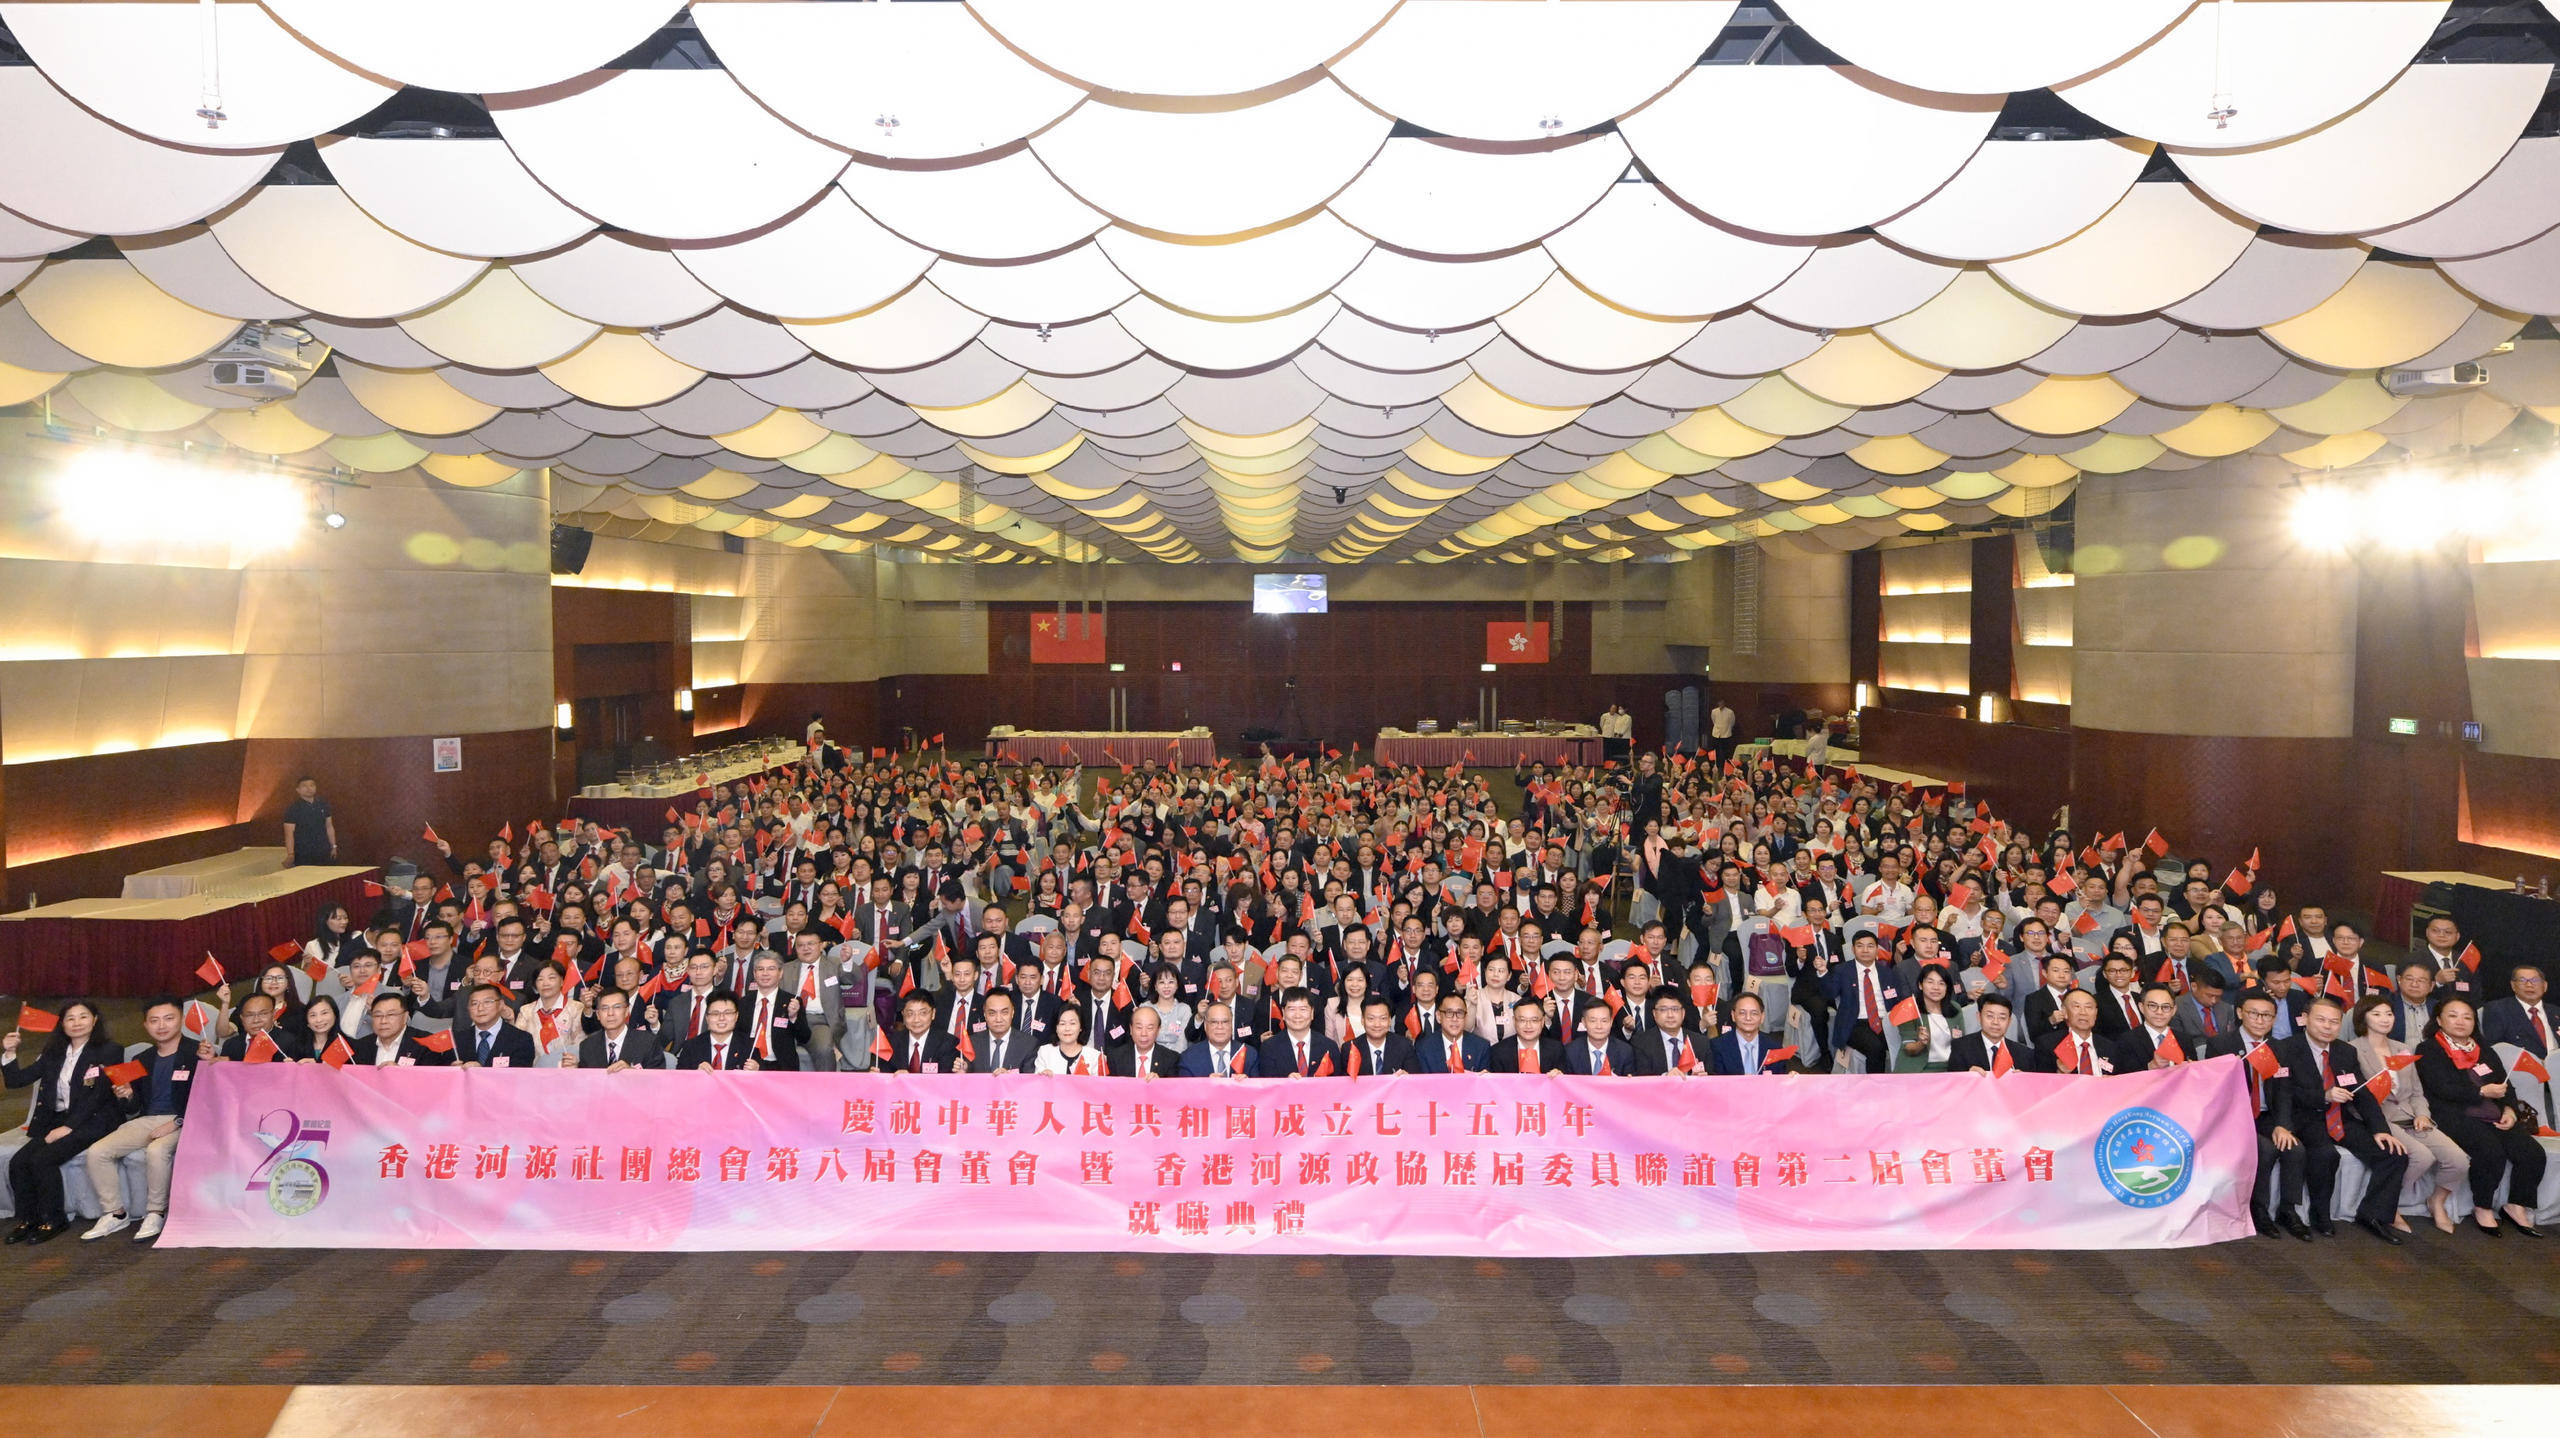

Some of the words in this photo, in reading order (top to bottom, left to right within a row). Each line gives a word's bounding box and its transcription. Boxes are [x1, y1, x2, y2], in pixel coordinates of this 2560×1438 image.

[841, 1097, 1596, 1139] 慶祝中華人民共和國成立七十五周年
[245, 1108, 331, 1203] 25
[378, 1143, 1039, 1186] 香港河源社團總會第八屆會董會
[1080, 1150, 1114, 1186] 暨
[1153, 1146, 2056, 1187] 香港河源政協歷屆委員聯誼會第二屆會董會
[1127, 1200, 1306, 1236] 就職典禮
